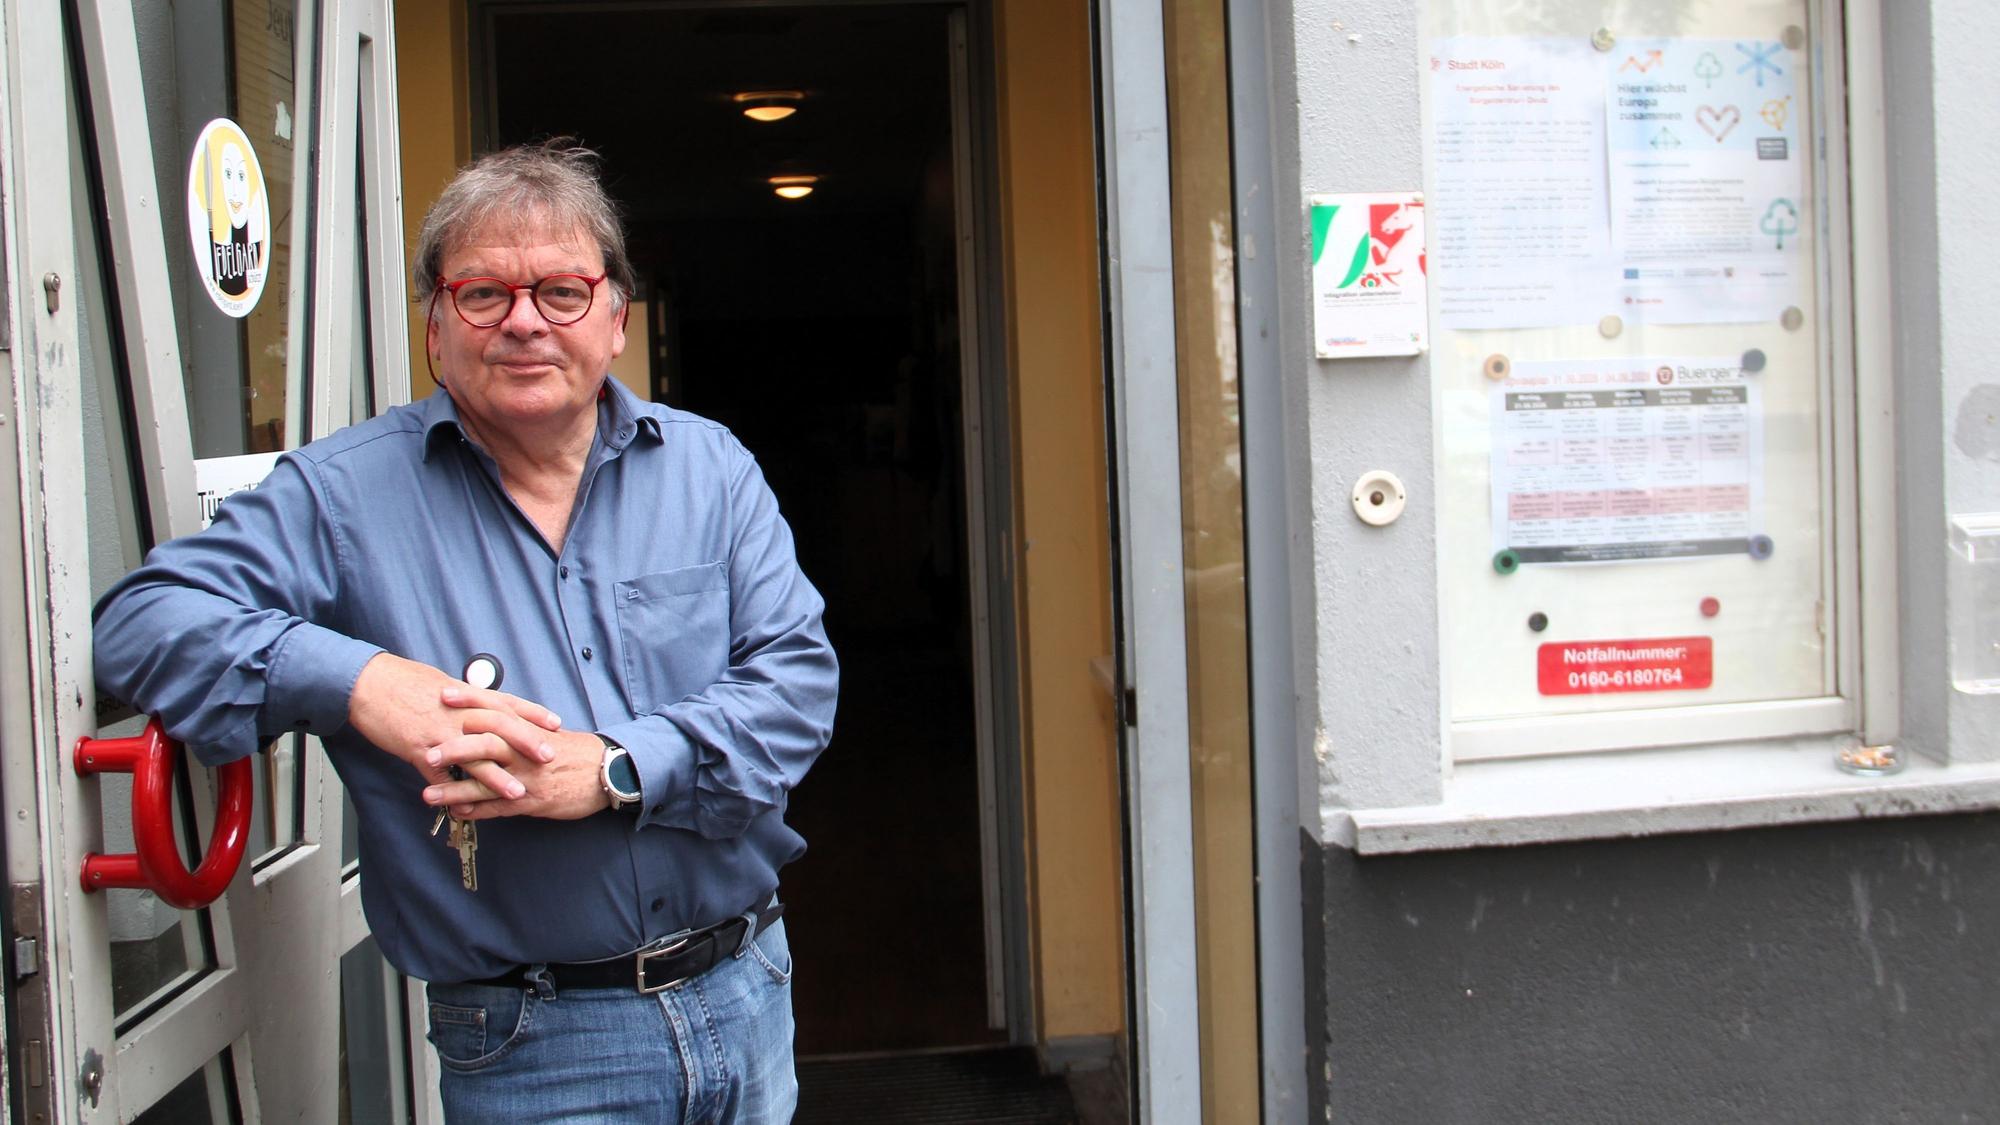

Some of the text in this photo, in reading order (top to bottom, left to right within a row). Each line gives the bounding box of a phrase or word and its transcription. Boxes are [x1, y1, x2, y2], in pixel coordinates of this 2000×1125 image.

[1448, 59, 1505, 71] Stadt Köln
[1617, 82, 1687, 94] Hier wächst
[1618, 97, 1658, 109] Europa
[1619, 112, 1682, 121] zusammen
[1563, 646, 1687, 664] Notfallnummer:
[1568, 667, 1682, 688] 0160-6180764
